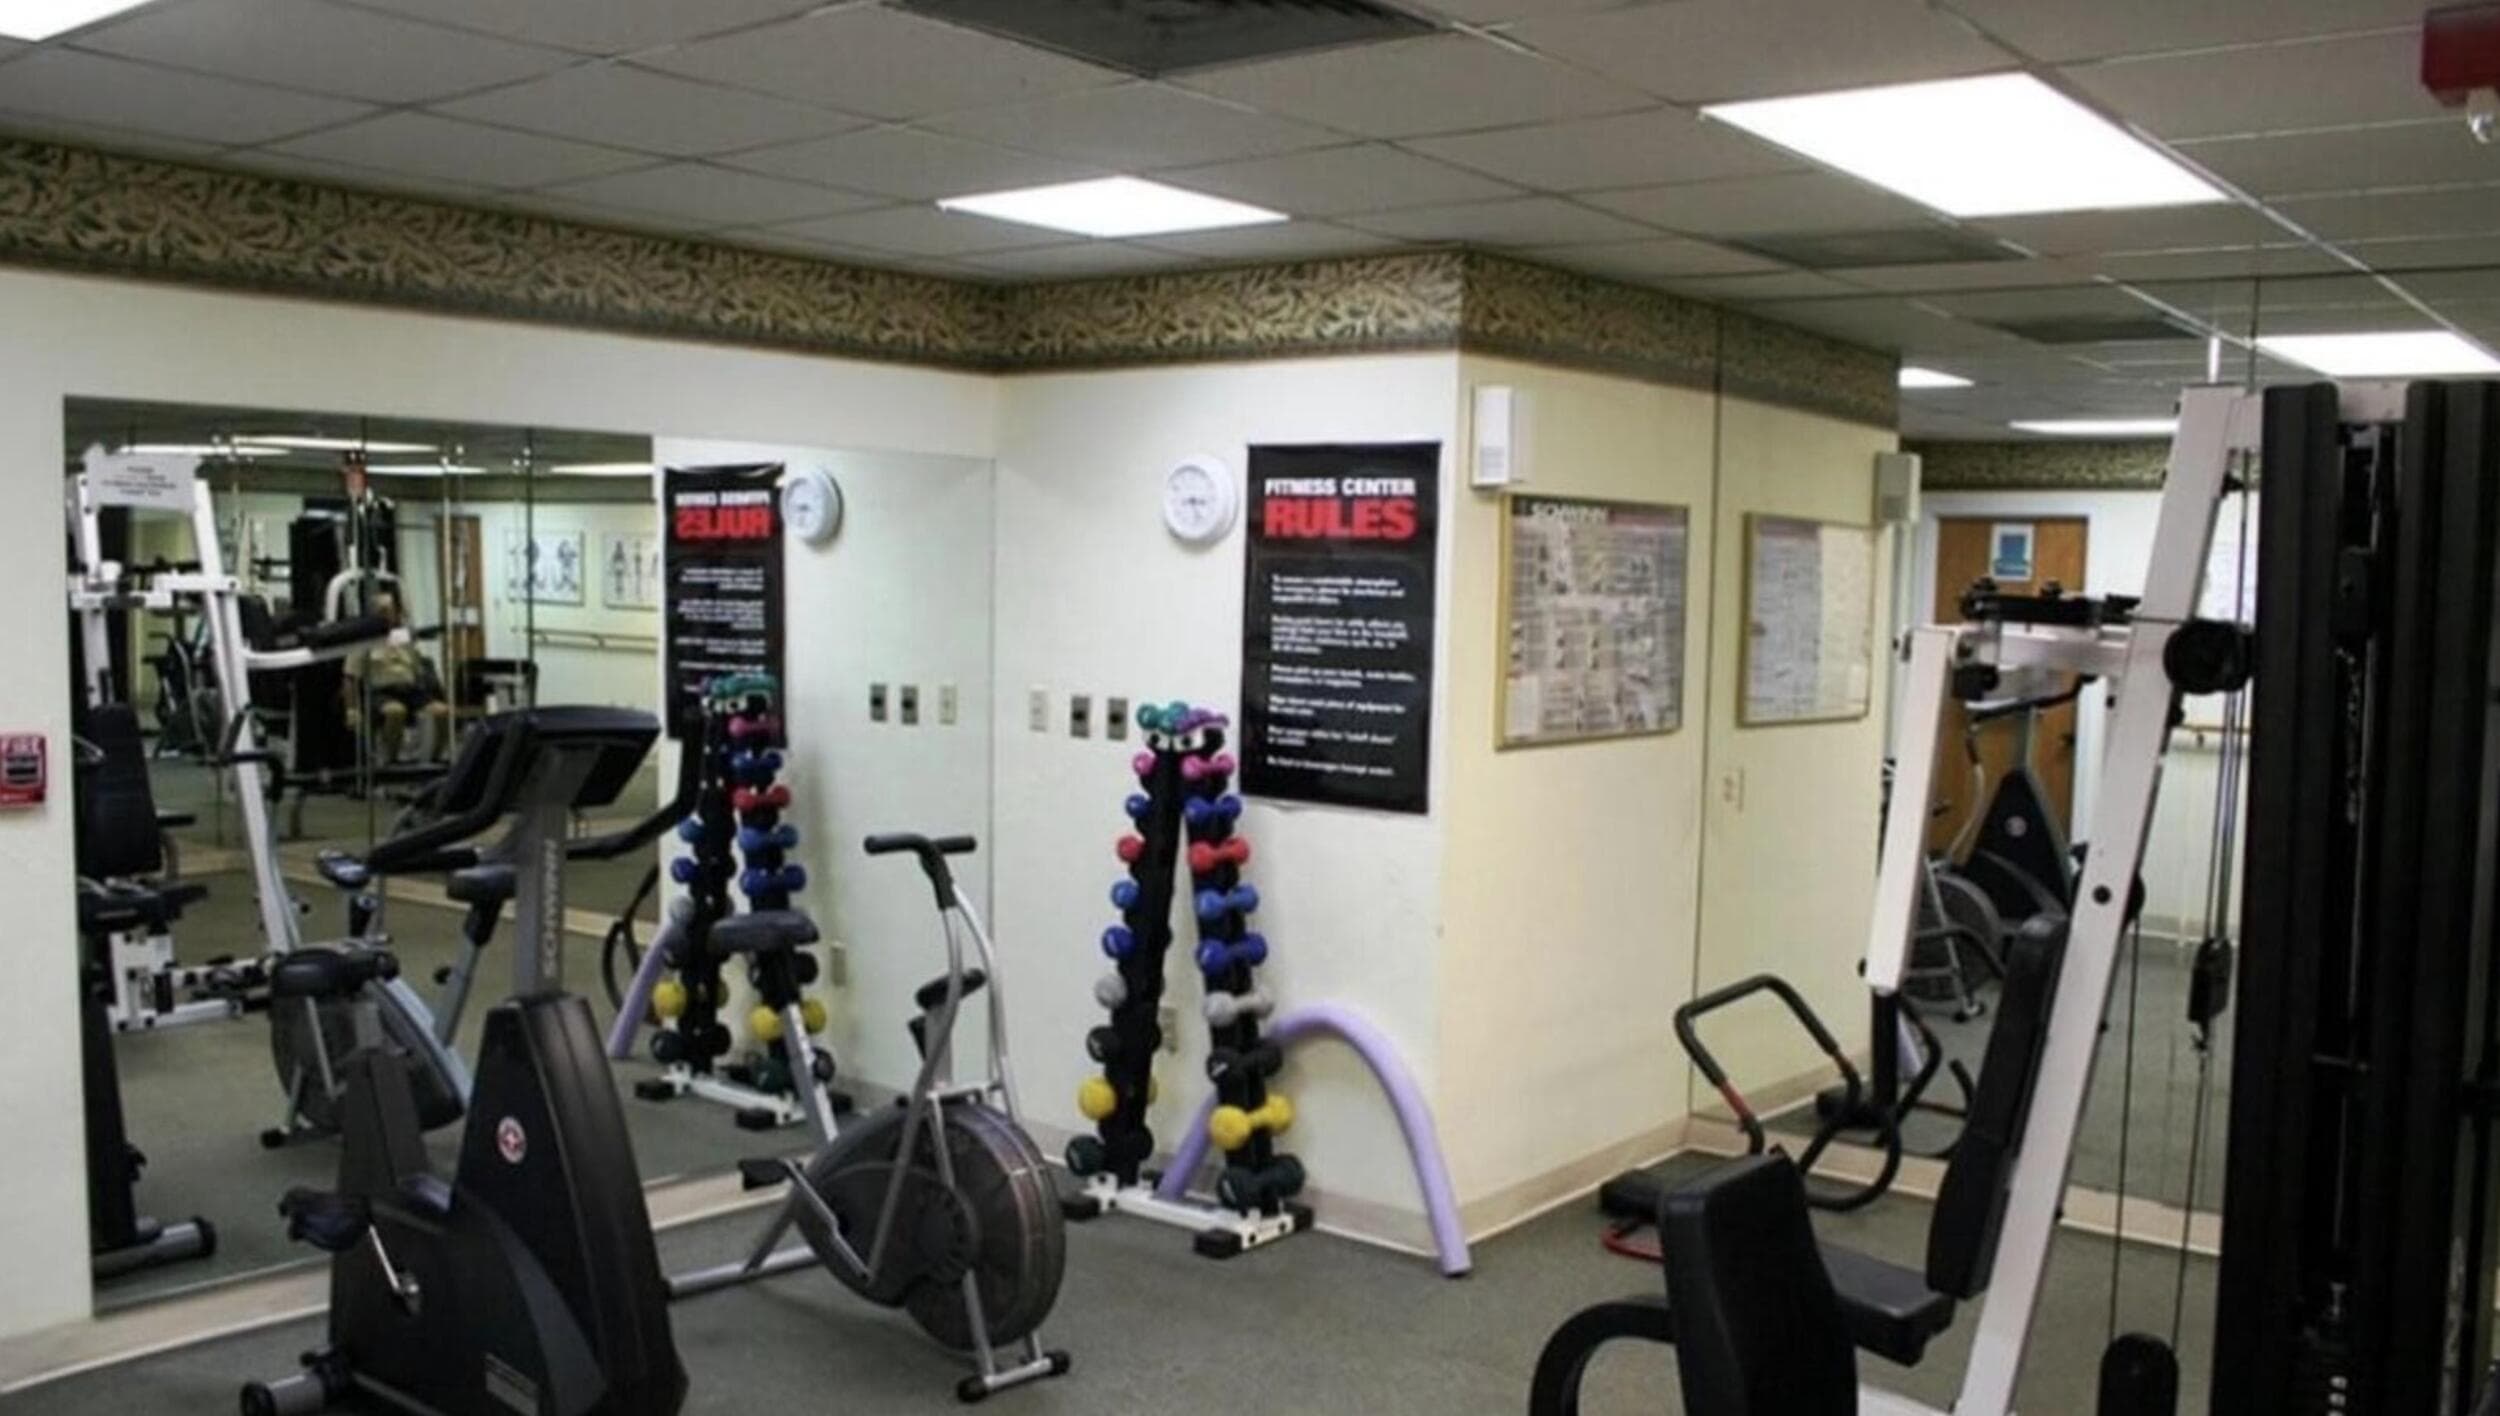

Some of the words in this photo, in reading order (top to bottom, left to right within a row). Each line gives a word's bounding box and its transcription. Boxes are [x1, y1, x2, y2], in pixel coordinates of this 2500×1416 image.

[1264, 477, 1336, 496] FITNESS
[1341, 477, 1416, 496] CENTER
[1264, 498, 1417, 540] RULES
